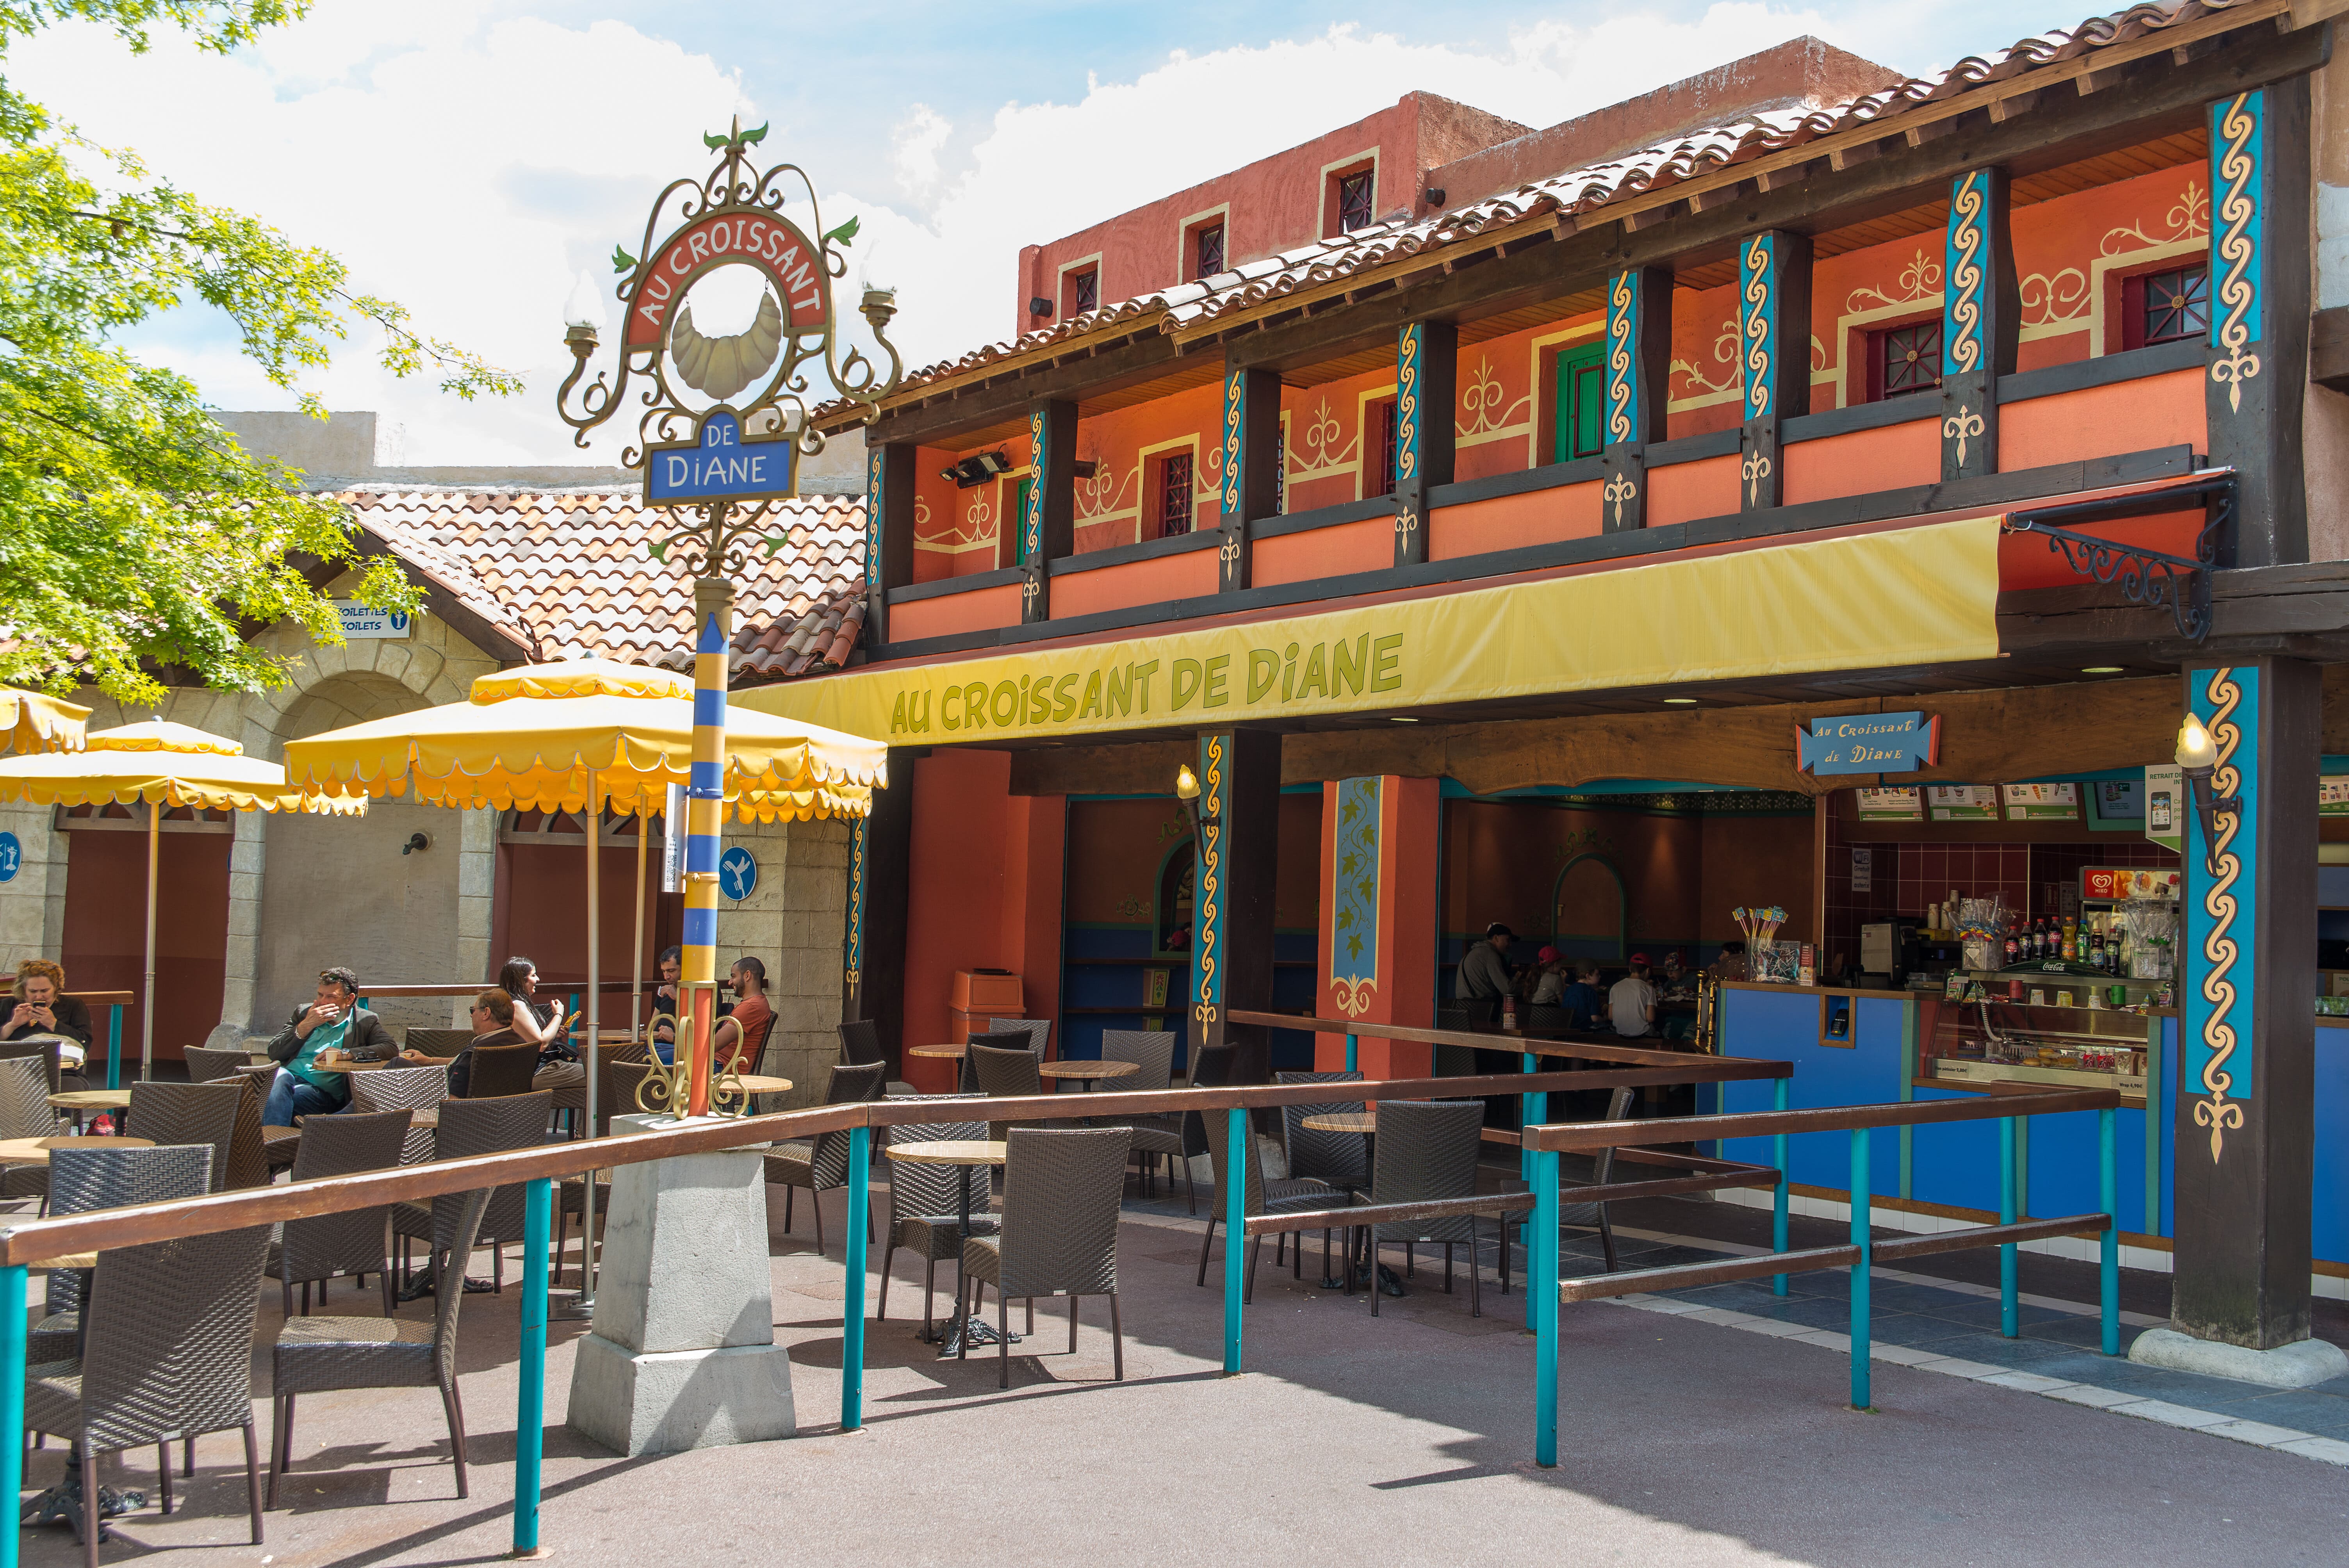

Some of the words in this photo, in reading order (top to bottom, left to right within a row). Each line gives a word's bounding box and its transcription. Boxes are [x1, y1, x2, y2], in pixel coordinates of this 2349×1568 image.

[640, 274, 671, 326] AU
[670, 220, 821, 310] CROISSANT
[707, 424, 734, 448] DE
[890, 689, 931, 734] AU
[1171, 654, 1230, 712] DE
[1814, 727, 1832, 737] Au
